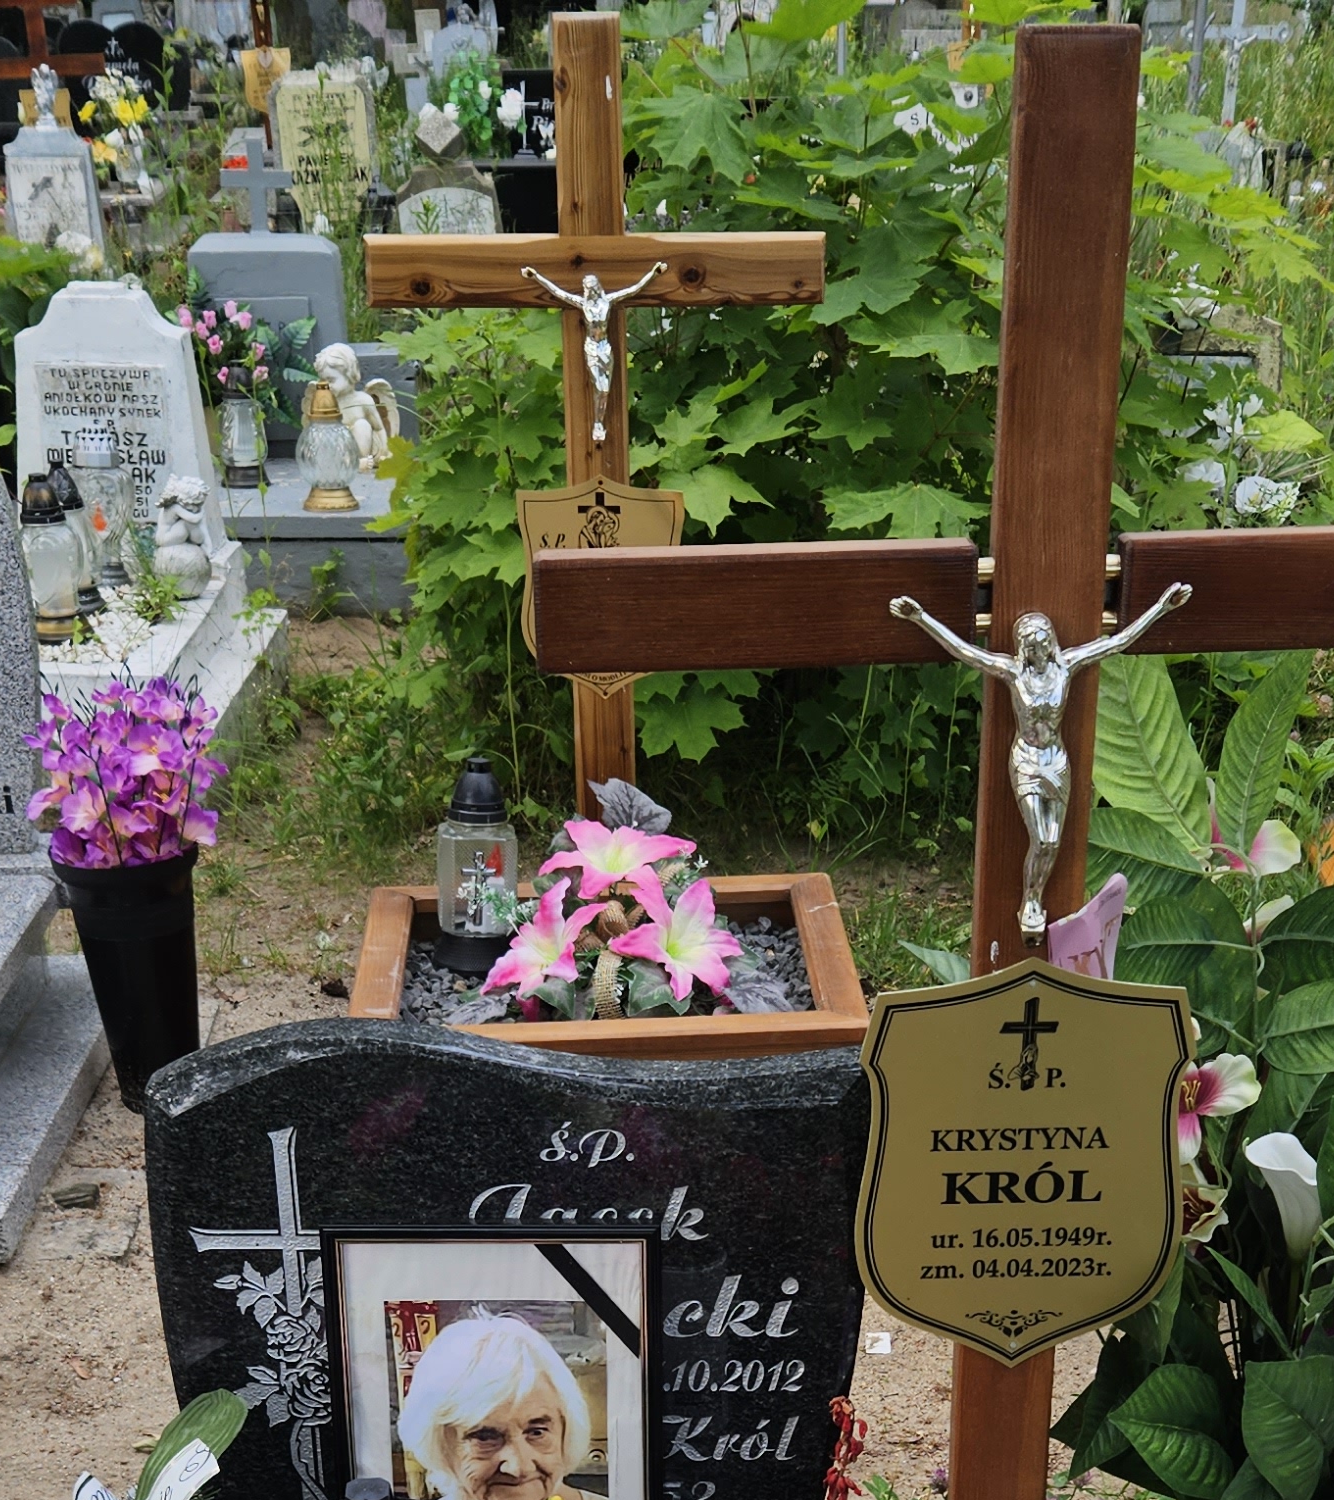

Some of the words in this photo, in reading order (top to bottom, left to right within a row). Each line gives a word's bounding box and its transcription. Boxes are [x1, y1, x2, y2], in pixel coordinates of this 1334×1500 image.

[43, 405, 116, 417] UKOCHANY
[119, 407, 162, 419] SYNEK
[987, 1062, 1012, 1090] Ś.
[1044, 1067, 1067, 1089] P.
[929, 1126, 1111, 1153] KRYSTYNA
[940, 1160, 1104, 1206] KRÓL
[930, 1232, 966, 1250] ur.
[971, 1226, 1114, 1249] 16.05.1949r.
[919, 1264, 966, 1281] zm.
[971, 1257, 1114, 1280] 04.04.2023r.
[663, 1275, 804, 1340] cki
[662, 1359, 806, 1395] .10.2012
[663, 1414, 799, 1463] Król
